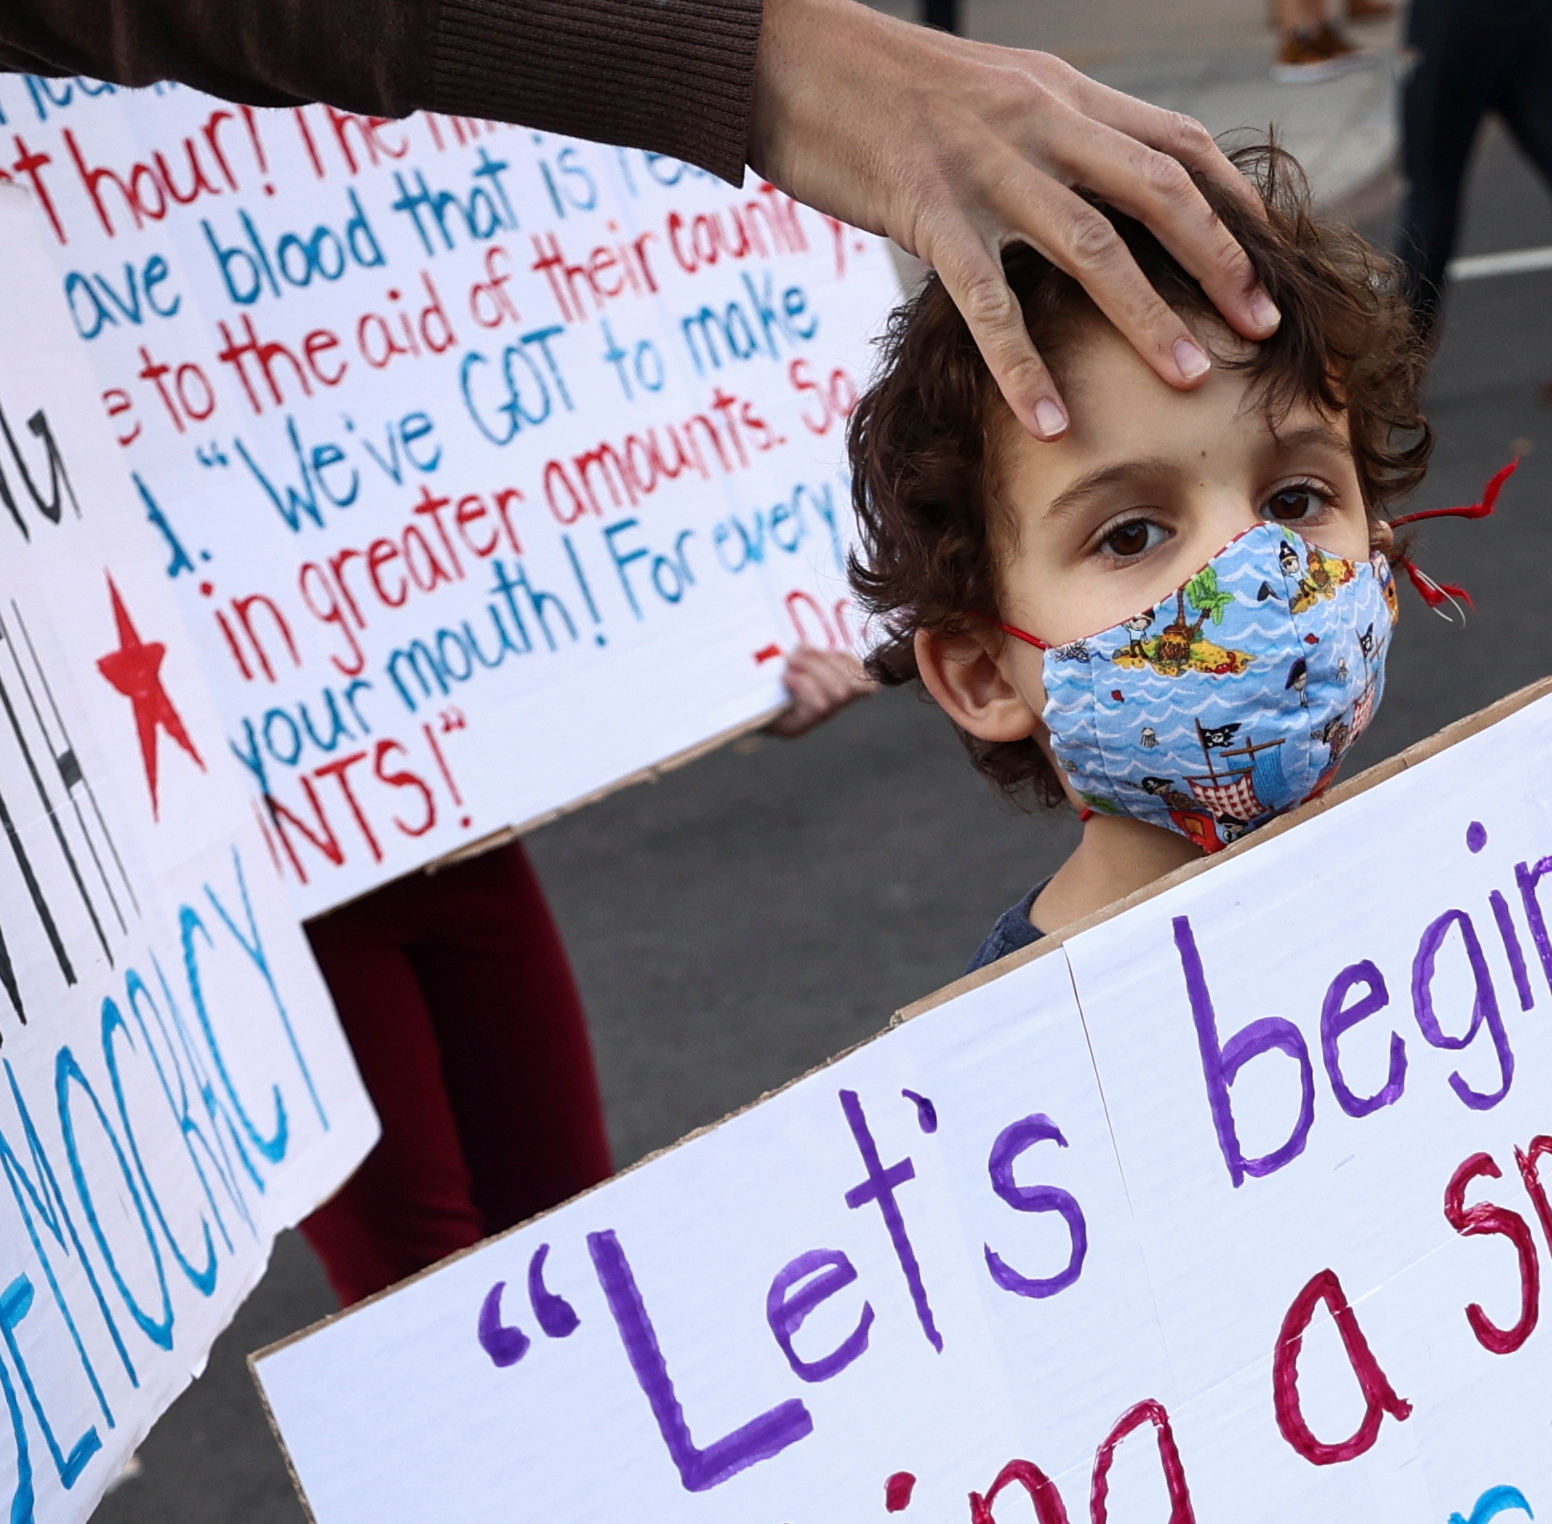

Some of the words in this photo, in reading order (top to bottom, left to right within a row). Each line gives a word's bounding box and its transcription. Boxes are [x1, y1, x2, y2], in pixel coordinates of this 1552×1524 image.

[61, 104, 277, 239] hour!
[200, 184, 386, 307] blood
[390, 145, 519, 257] that
[531, 132, 598, 219] is
[136, 346, 217, 434] to
[219, 312, 348, 415] the
[357, 271, 456, 370] aid
[469, 244, 516, 329] of
[531, 219, 663, 325] their
[459, 324, 576, 448] GOT
[602, 316, 666, 402] to
[680, 269, 820, 381] make
[198, 578, 301, 686] in
[297, 483, 525, 679] greater
[542, 386, 788, 528] amounts.
[228, 677, 376, 828] your
[383, 532, 609, 714] mouth!
[602, 515, 696, 622] For
[250, 704, 468, 887] NTS!"
[477, 1087, 1089, 1493] "Let's
[1271, 1267, 1414, 1466] a
